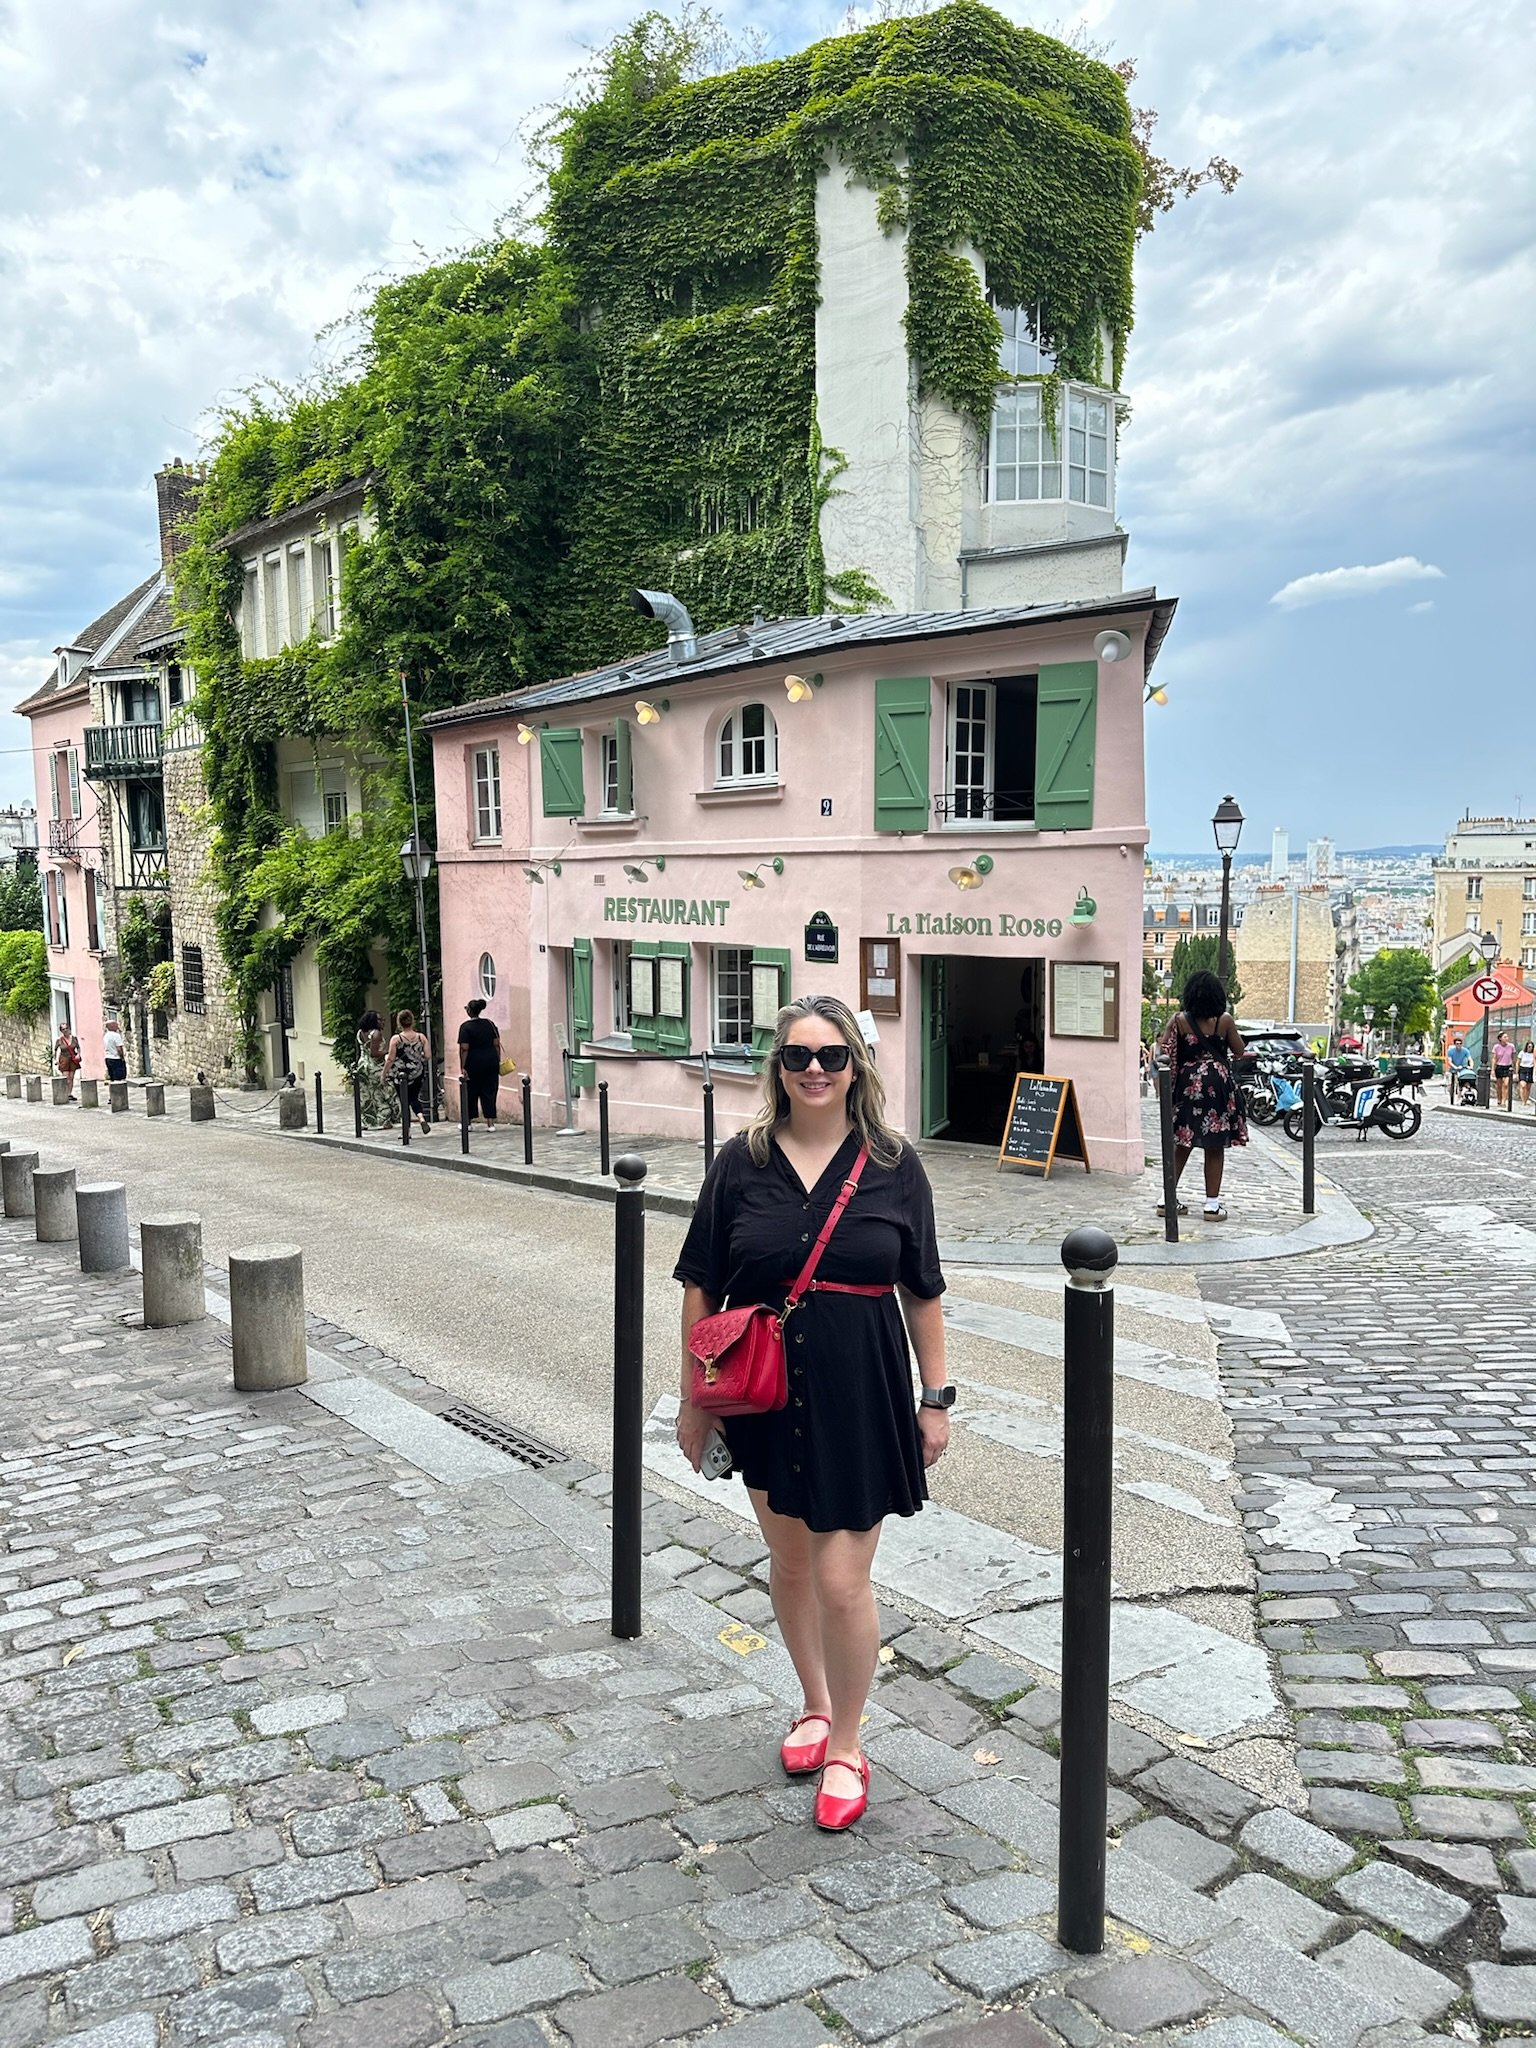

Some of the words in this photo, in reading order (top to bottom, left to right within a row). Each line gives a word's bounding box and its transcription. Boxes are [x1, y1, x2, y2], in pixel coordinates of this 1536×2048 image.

[823, 800, 831, 816] 2
[604, 897, 730, 926] RESTAURANT
[886, 912, 912, 935] La
[915, 912, 993, 937] Maison
[998, 913, 1064, 938] Rose
